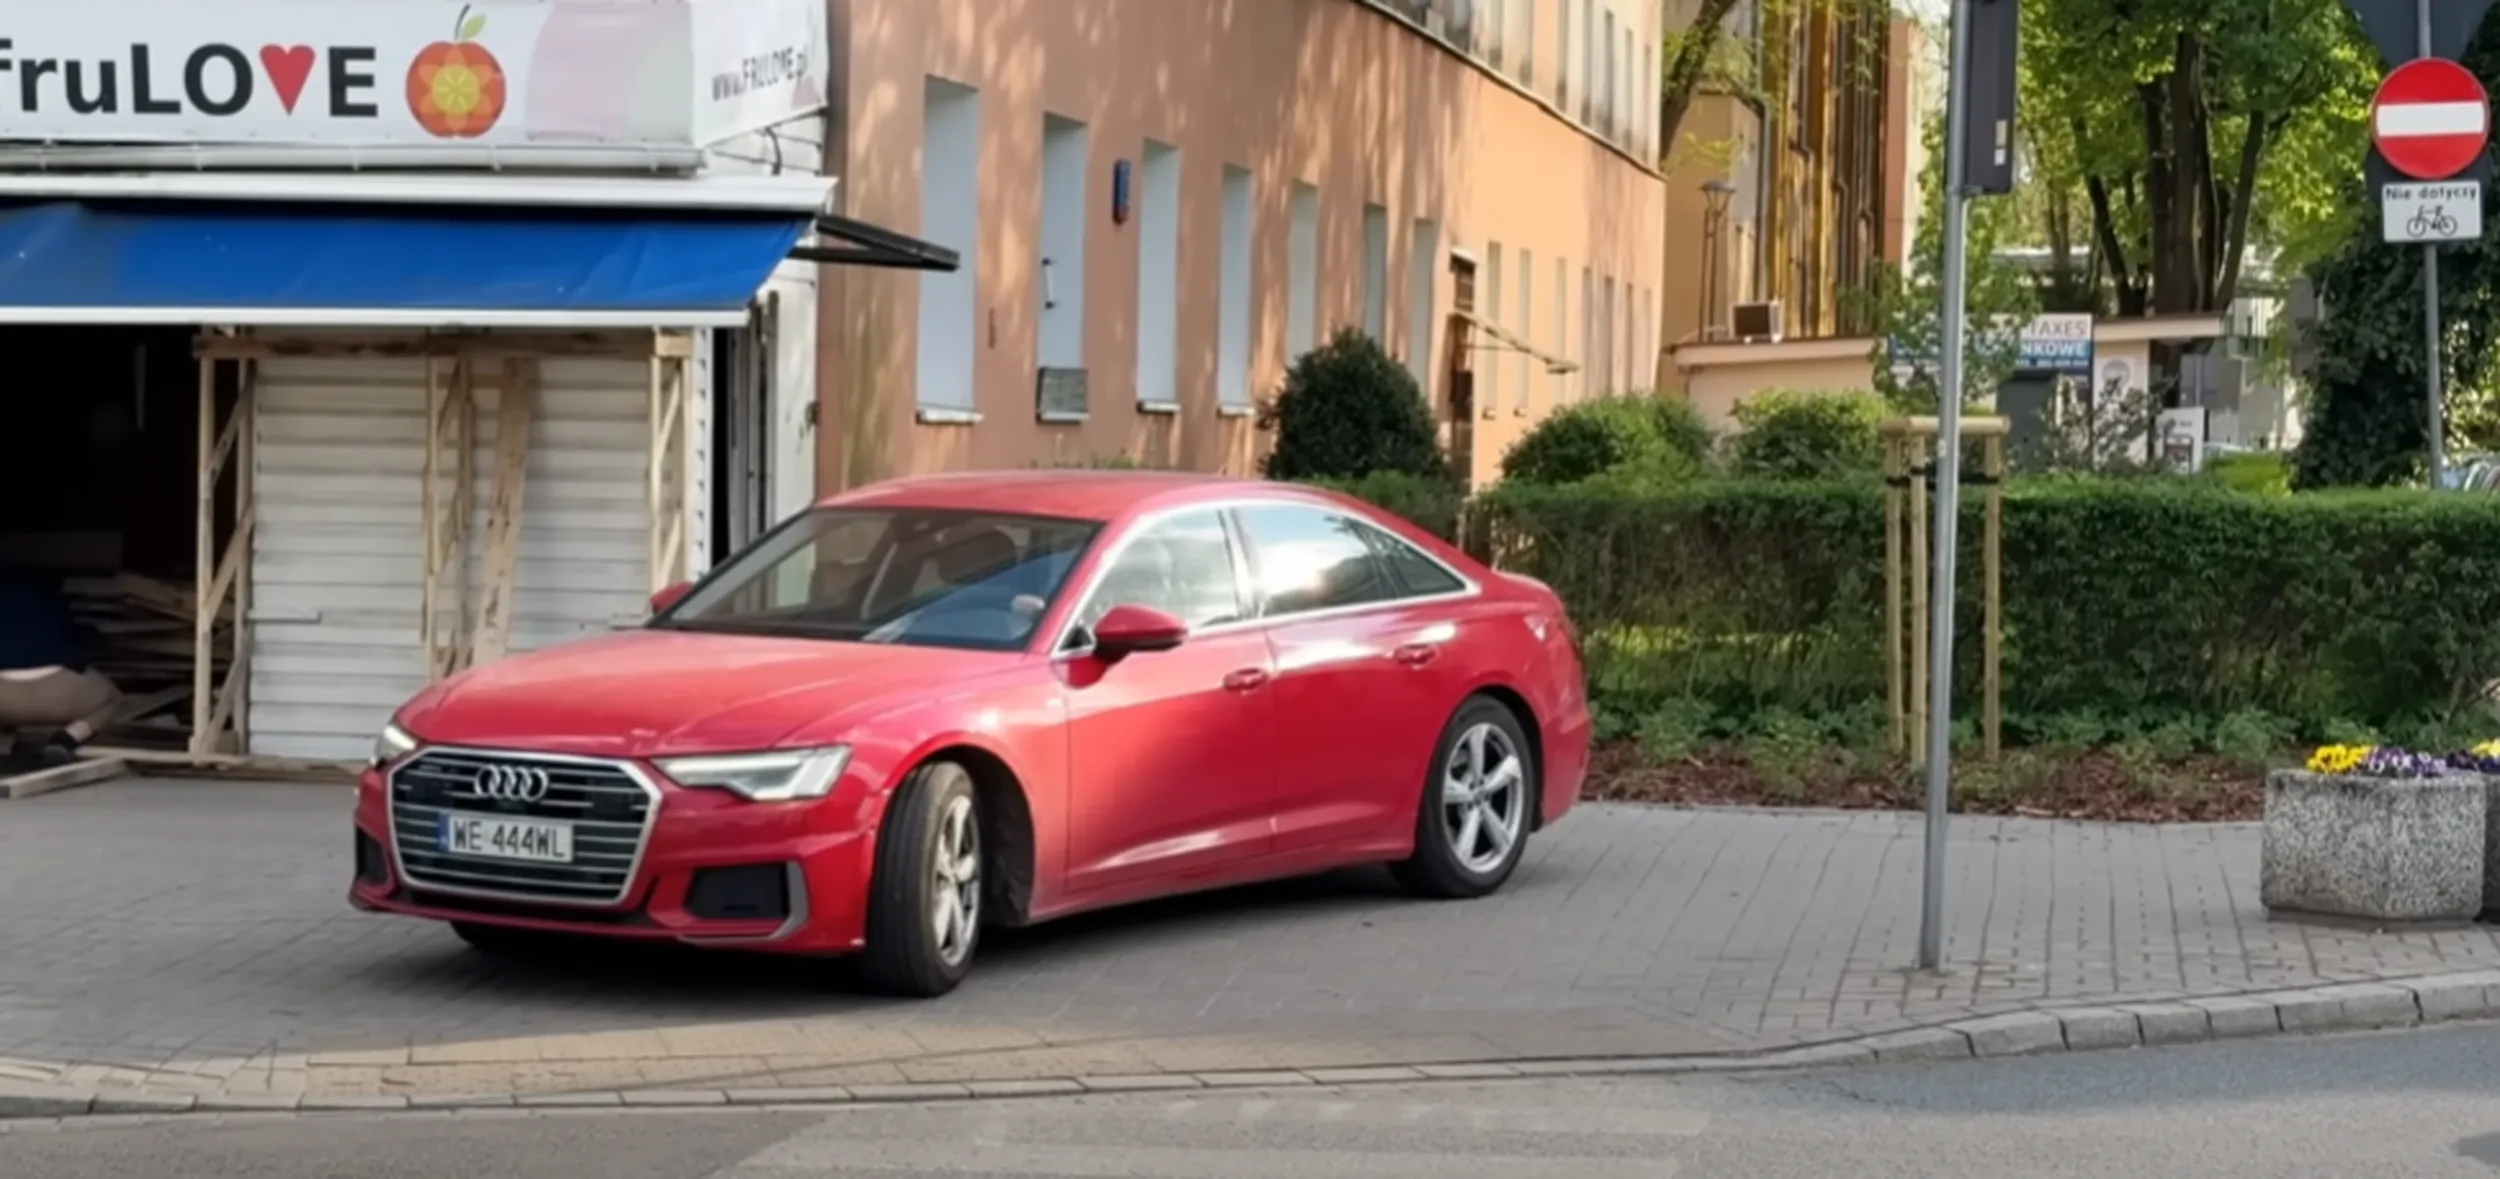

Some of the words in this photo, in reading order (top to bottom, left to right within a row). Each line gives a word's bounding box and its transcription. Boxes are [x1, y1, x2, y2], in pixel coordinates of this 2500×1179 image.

[2385, 186, 2412, 200] Nie
[2418, 184, 2477, 201] dotyczy
[453, 819, 482, 851] WE
[491, 823, 566, 858] 444WL
